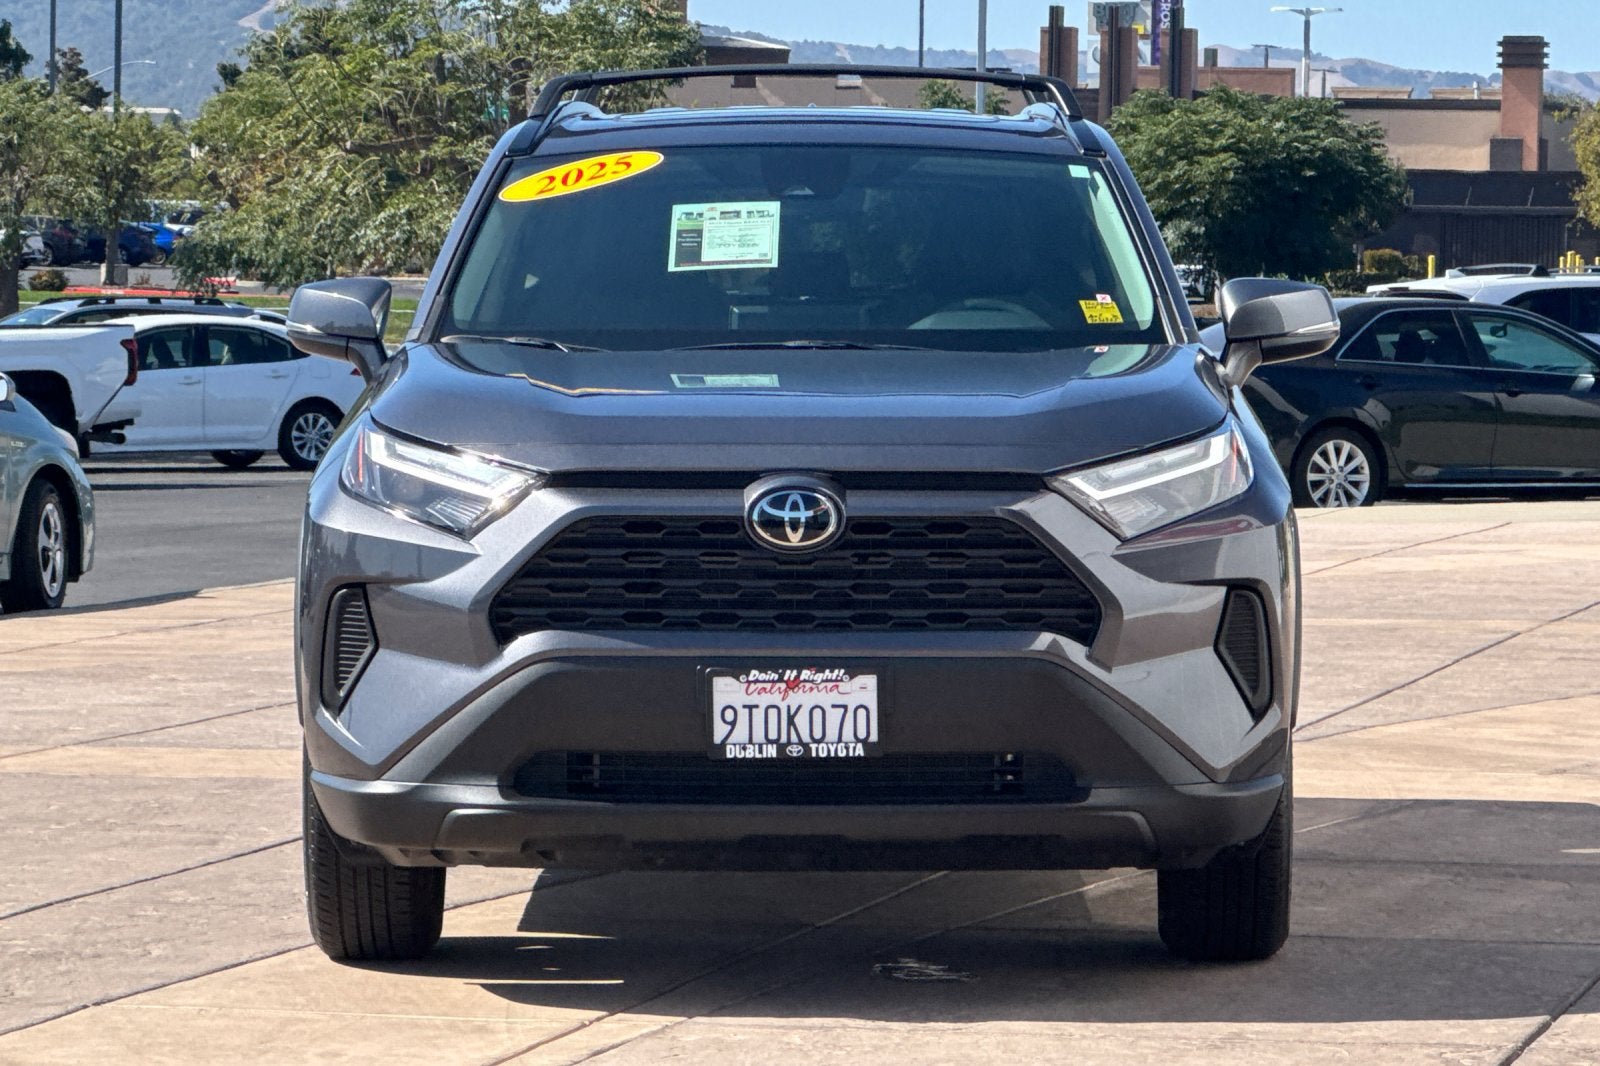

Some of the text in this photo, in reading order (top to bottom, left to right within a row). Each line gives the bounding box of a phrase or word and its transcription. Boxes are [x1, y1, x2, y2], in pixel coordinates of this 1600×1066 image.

[536, 155, 633, 196] 2025
[748, 669, 845, 684] Doin' It Right!
[744, 681, 852, 702] California
[726, 743, 865, 759] DUBLIN TOYOTA
